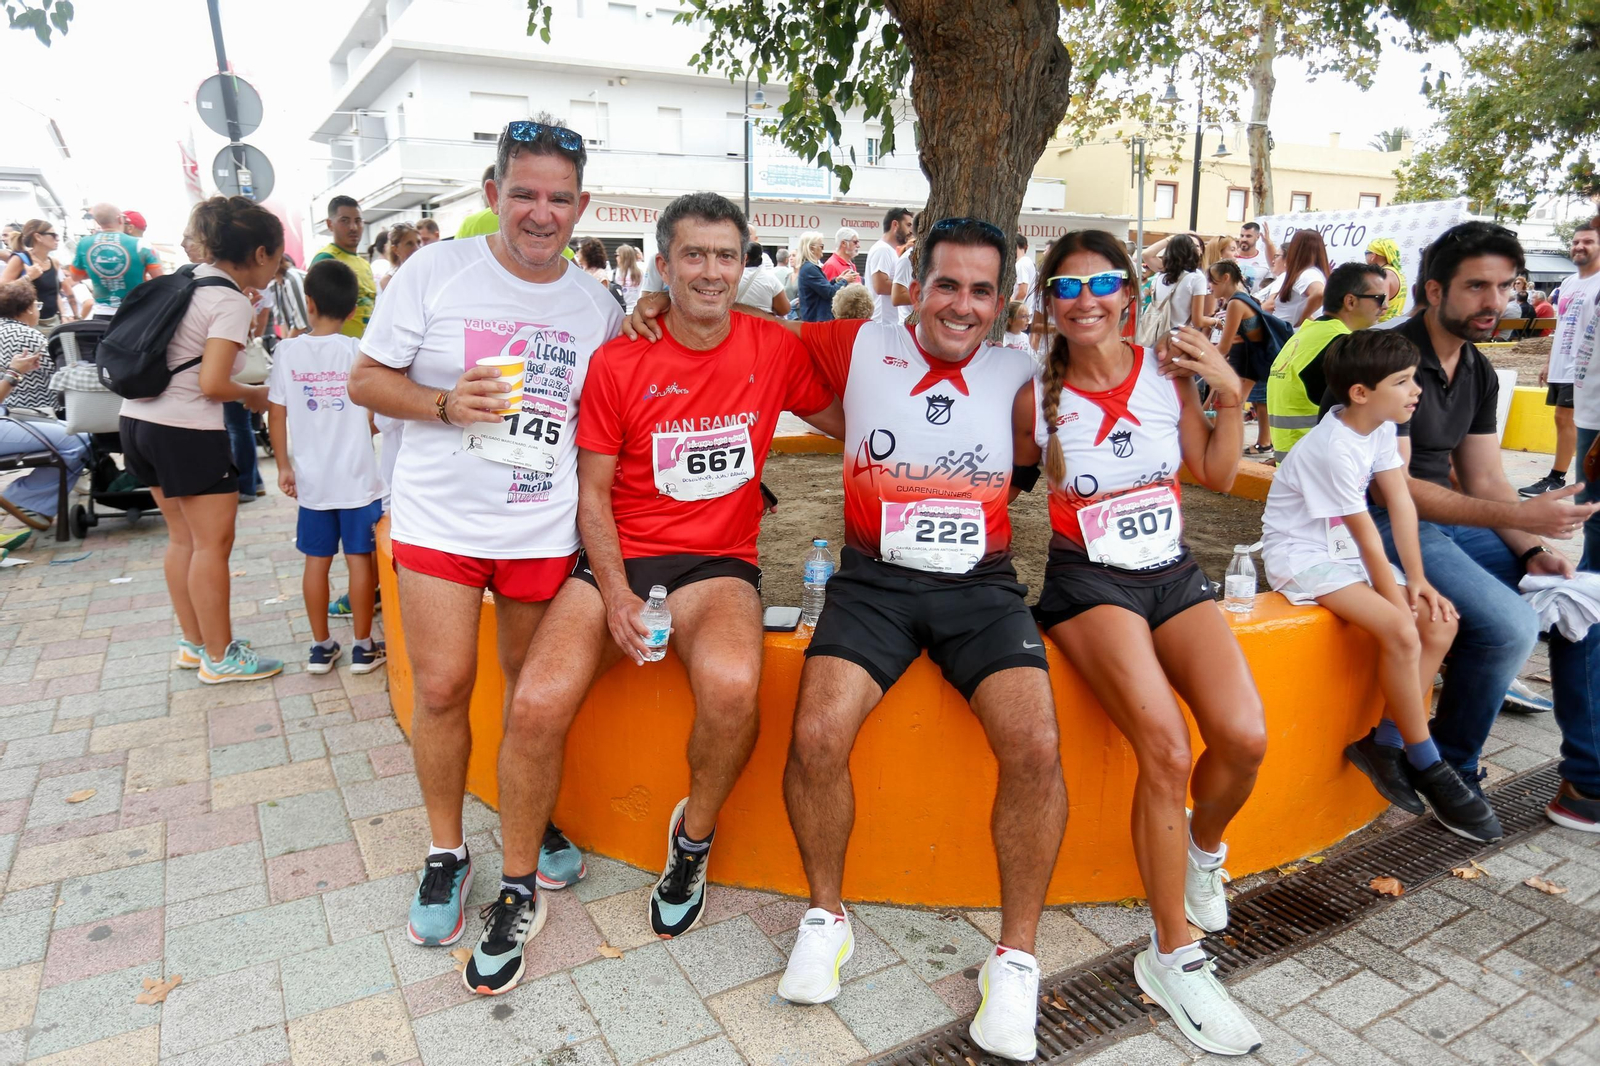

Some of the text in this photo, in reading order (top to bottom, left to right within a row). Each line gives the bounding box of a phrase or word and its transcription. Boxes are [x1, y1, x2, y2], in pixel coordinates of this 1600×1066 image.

[841, 217, 880, 229] Cruzcampo
[464, 318, 515, 334] Valores
[525, 373, 571, 393] FUERZA
[503, 413, 562, 446] 145
[699, 410, 760, 432] RAMON
[686, 446, 746, 475] 667
[508, 480, 553, 493] AMISTAD
[896, 485, 973, 499] CUARENRUNNERS
[915, 519, 979, 546] 222
[1116, 506, 1173, 541] 807
